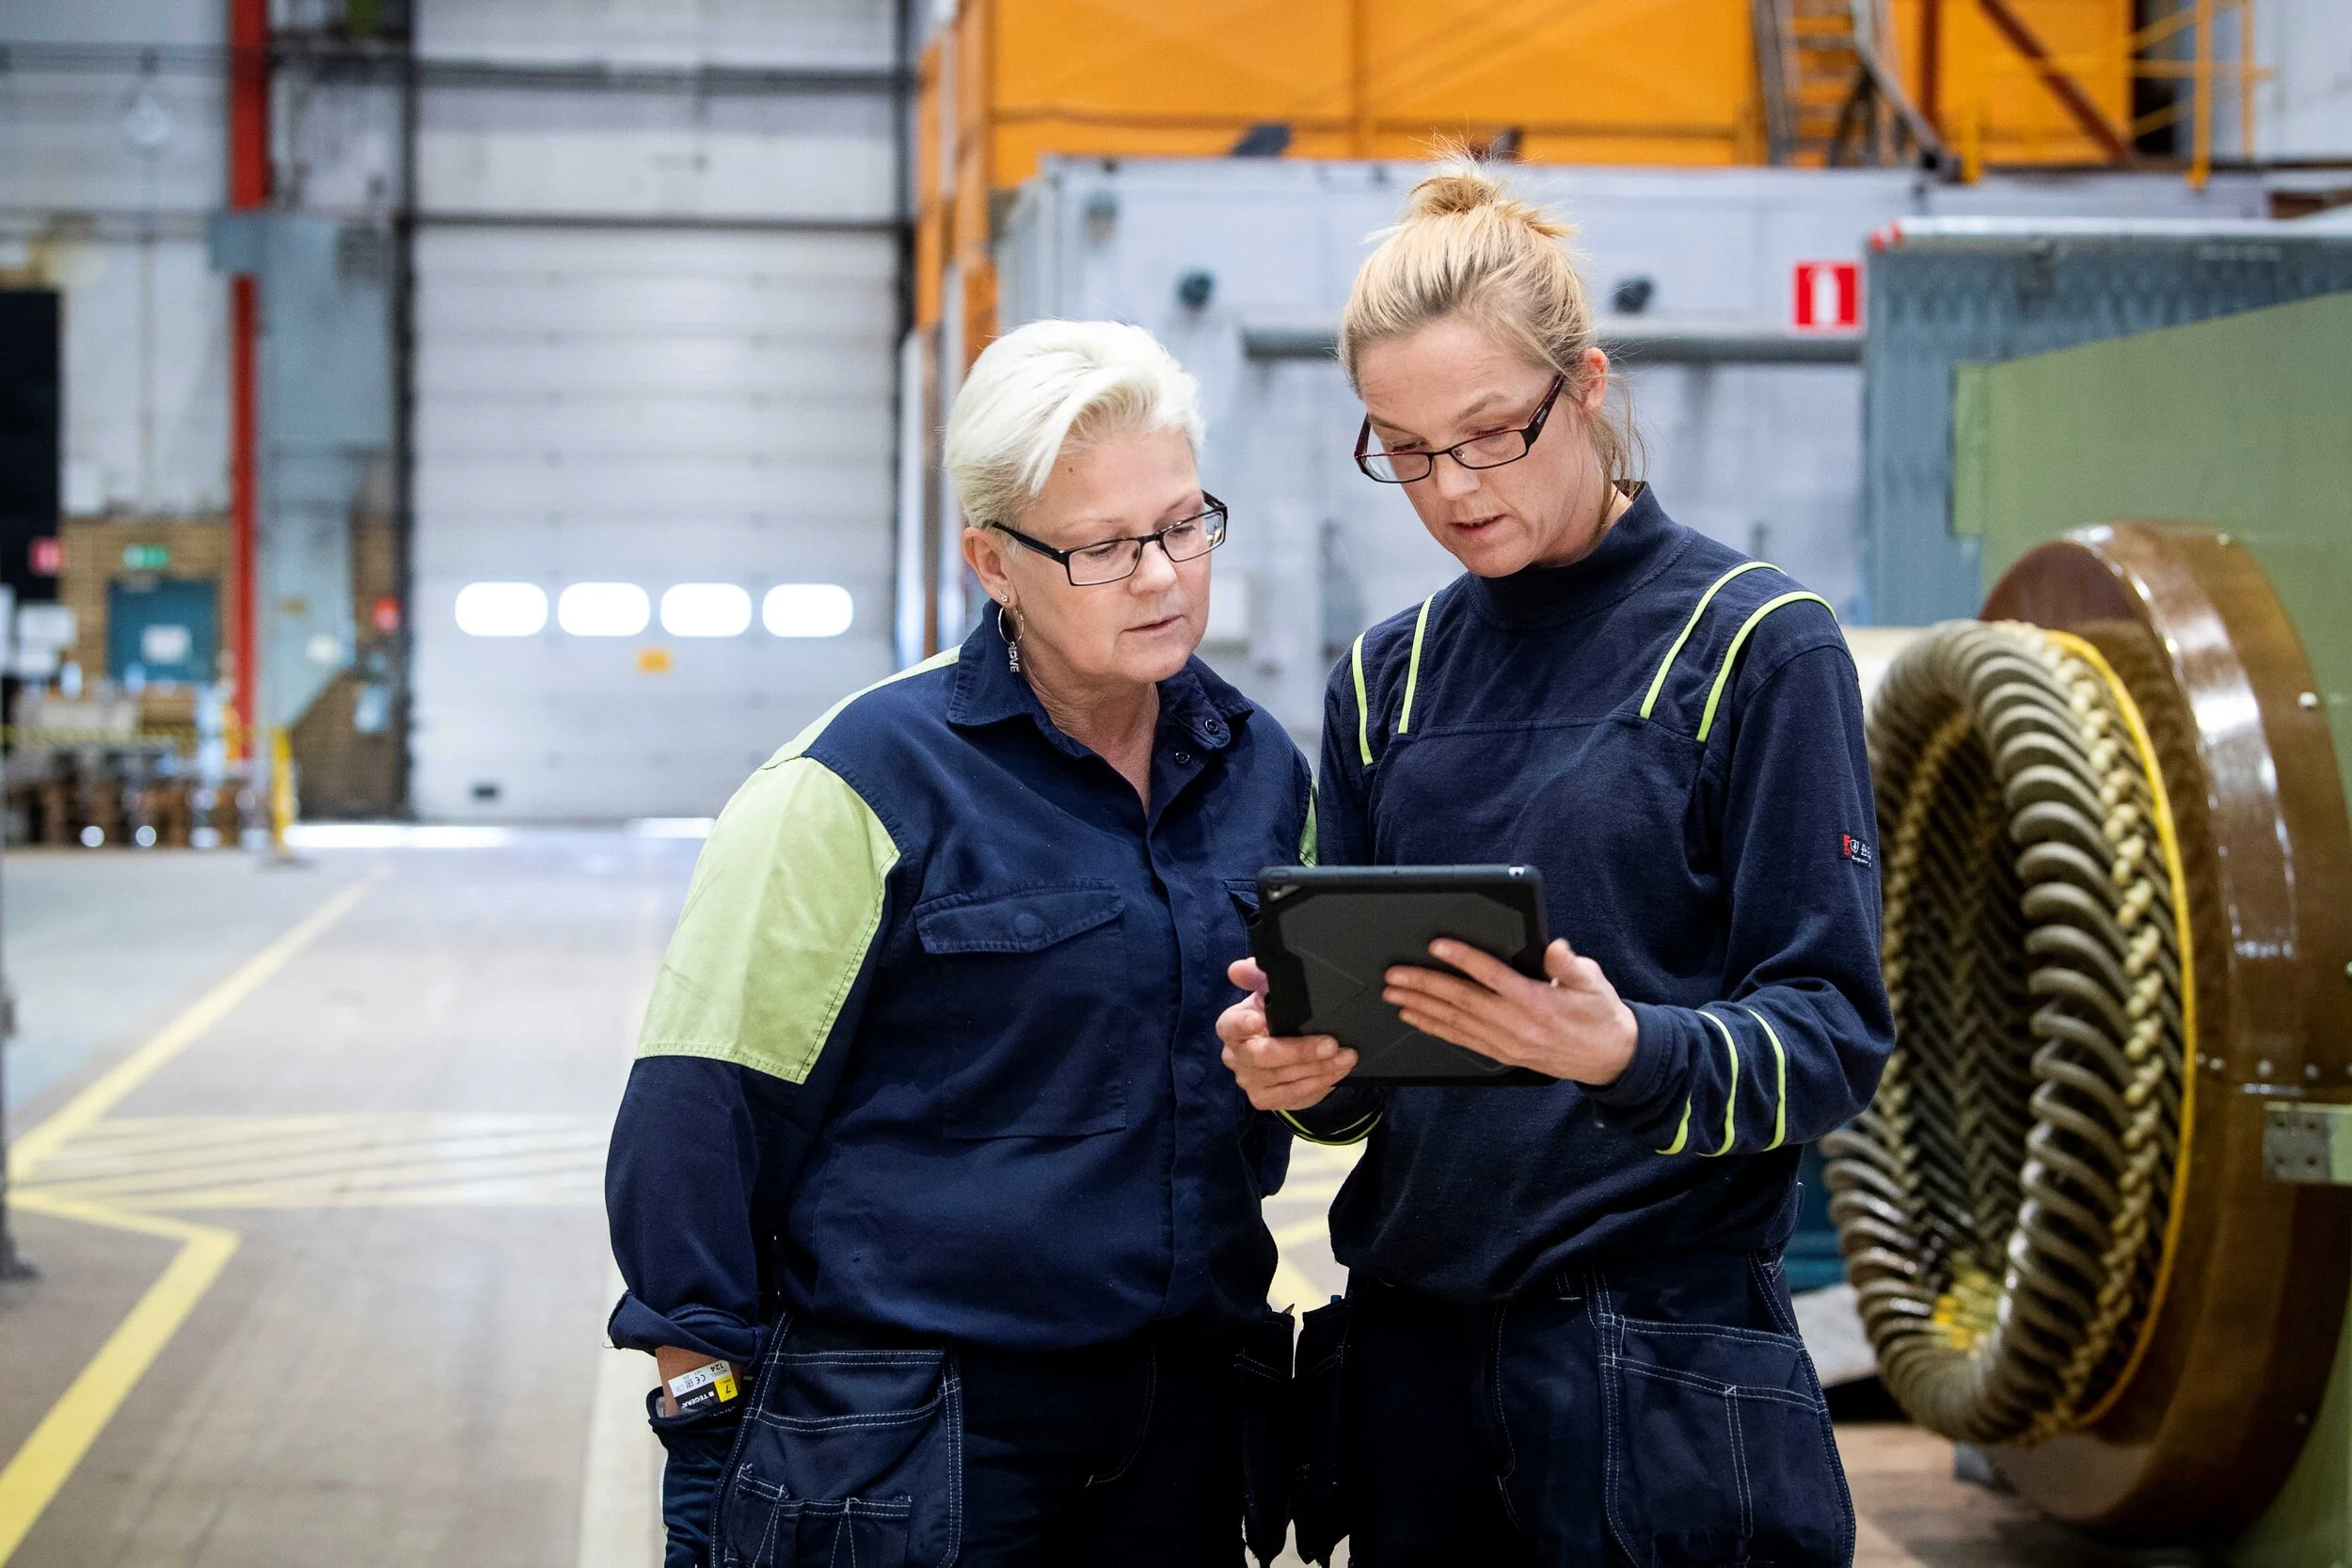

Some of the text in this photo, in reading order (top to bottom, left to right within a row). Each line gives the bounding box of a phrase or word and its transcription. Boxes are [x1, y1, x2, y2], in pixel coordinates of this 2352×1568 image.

[710, 1363, 723, 1372] 124
[724, 1385, 731, 1394] 7
[682, 1394, 708, 1408] TEGERA
